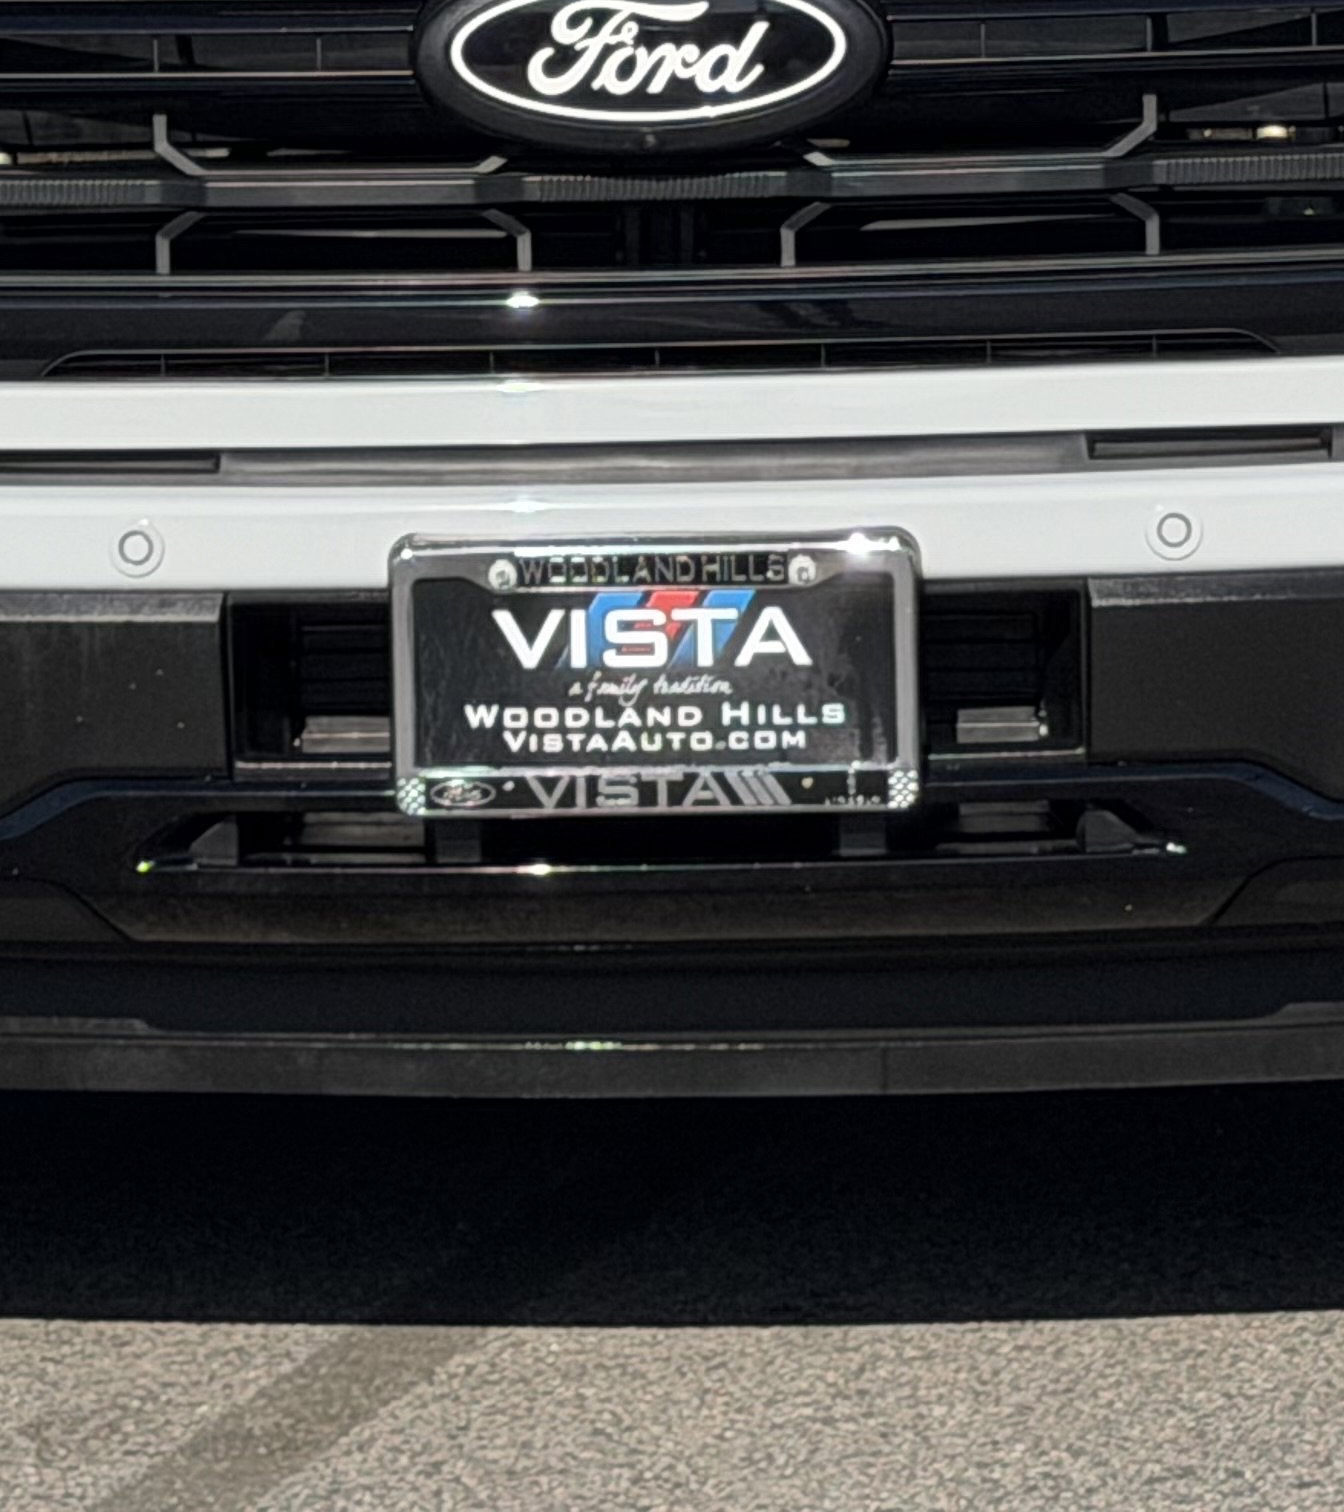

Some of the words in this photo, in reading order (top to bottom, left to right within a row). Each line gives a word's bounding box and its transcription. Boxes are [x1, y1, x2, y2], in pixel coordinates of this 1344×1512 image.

[518, 555, 696, 585] WOODLAND
[701, 553, 786, 583] HILLS
[492, 605, 813, 669] VISTA
[464, 703, 703, 729] WOODLAND
[720, 701, 846, 727] HILLS
[525, 774, 732, 808] VISTA
